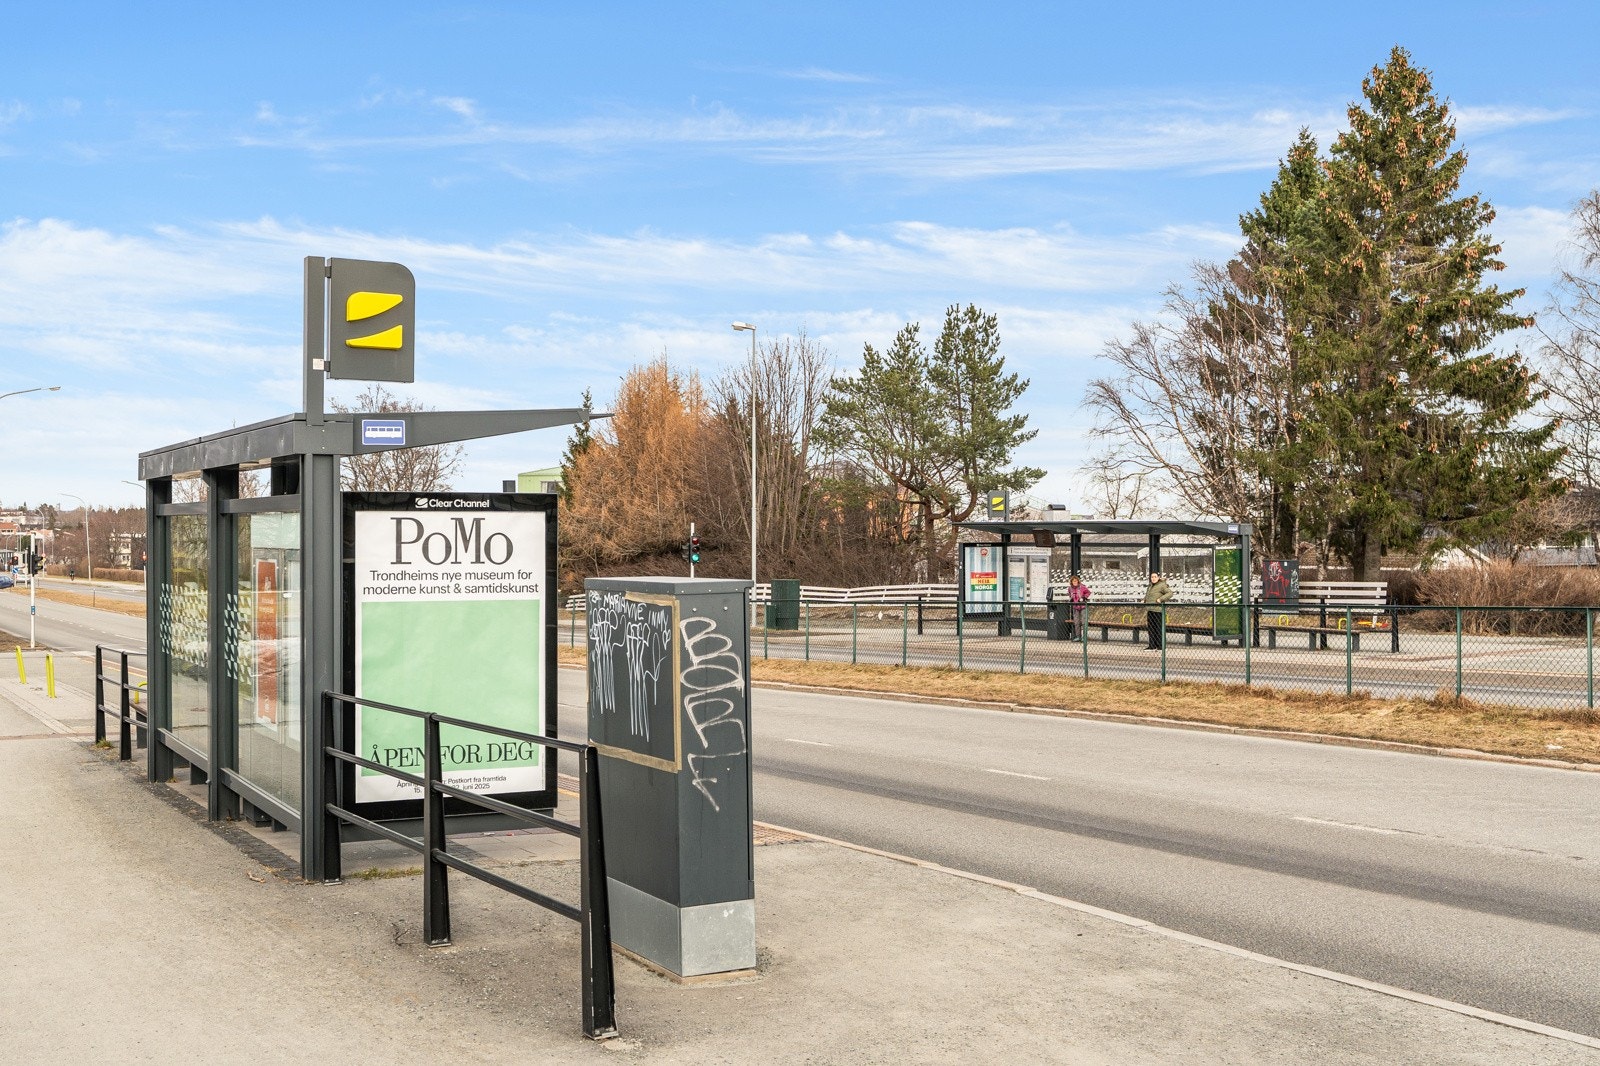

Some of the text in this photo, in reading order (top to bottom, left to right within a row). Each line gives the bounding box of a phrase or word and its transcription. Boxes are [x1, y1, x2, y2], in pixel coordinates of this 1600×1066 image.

[428, 498, 490, 508] Clear Channel
[390, 517, 514, 566] PoMo
[369, 569, 533, 582] Trondheims nye museum for
[363, 582, 539, 595] moderne kunst & samtidskunst
[441, 744, 482, 766] FOR
[486, 741, 534, 763] DEG
[447, 777, 472, 785] Postkort
[482, 775, 507, 783] framtida
[474, 782, 491, 790] 2025
